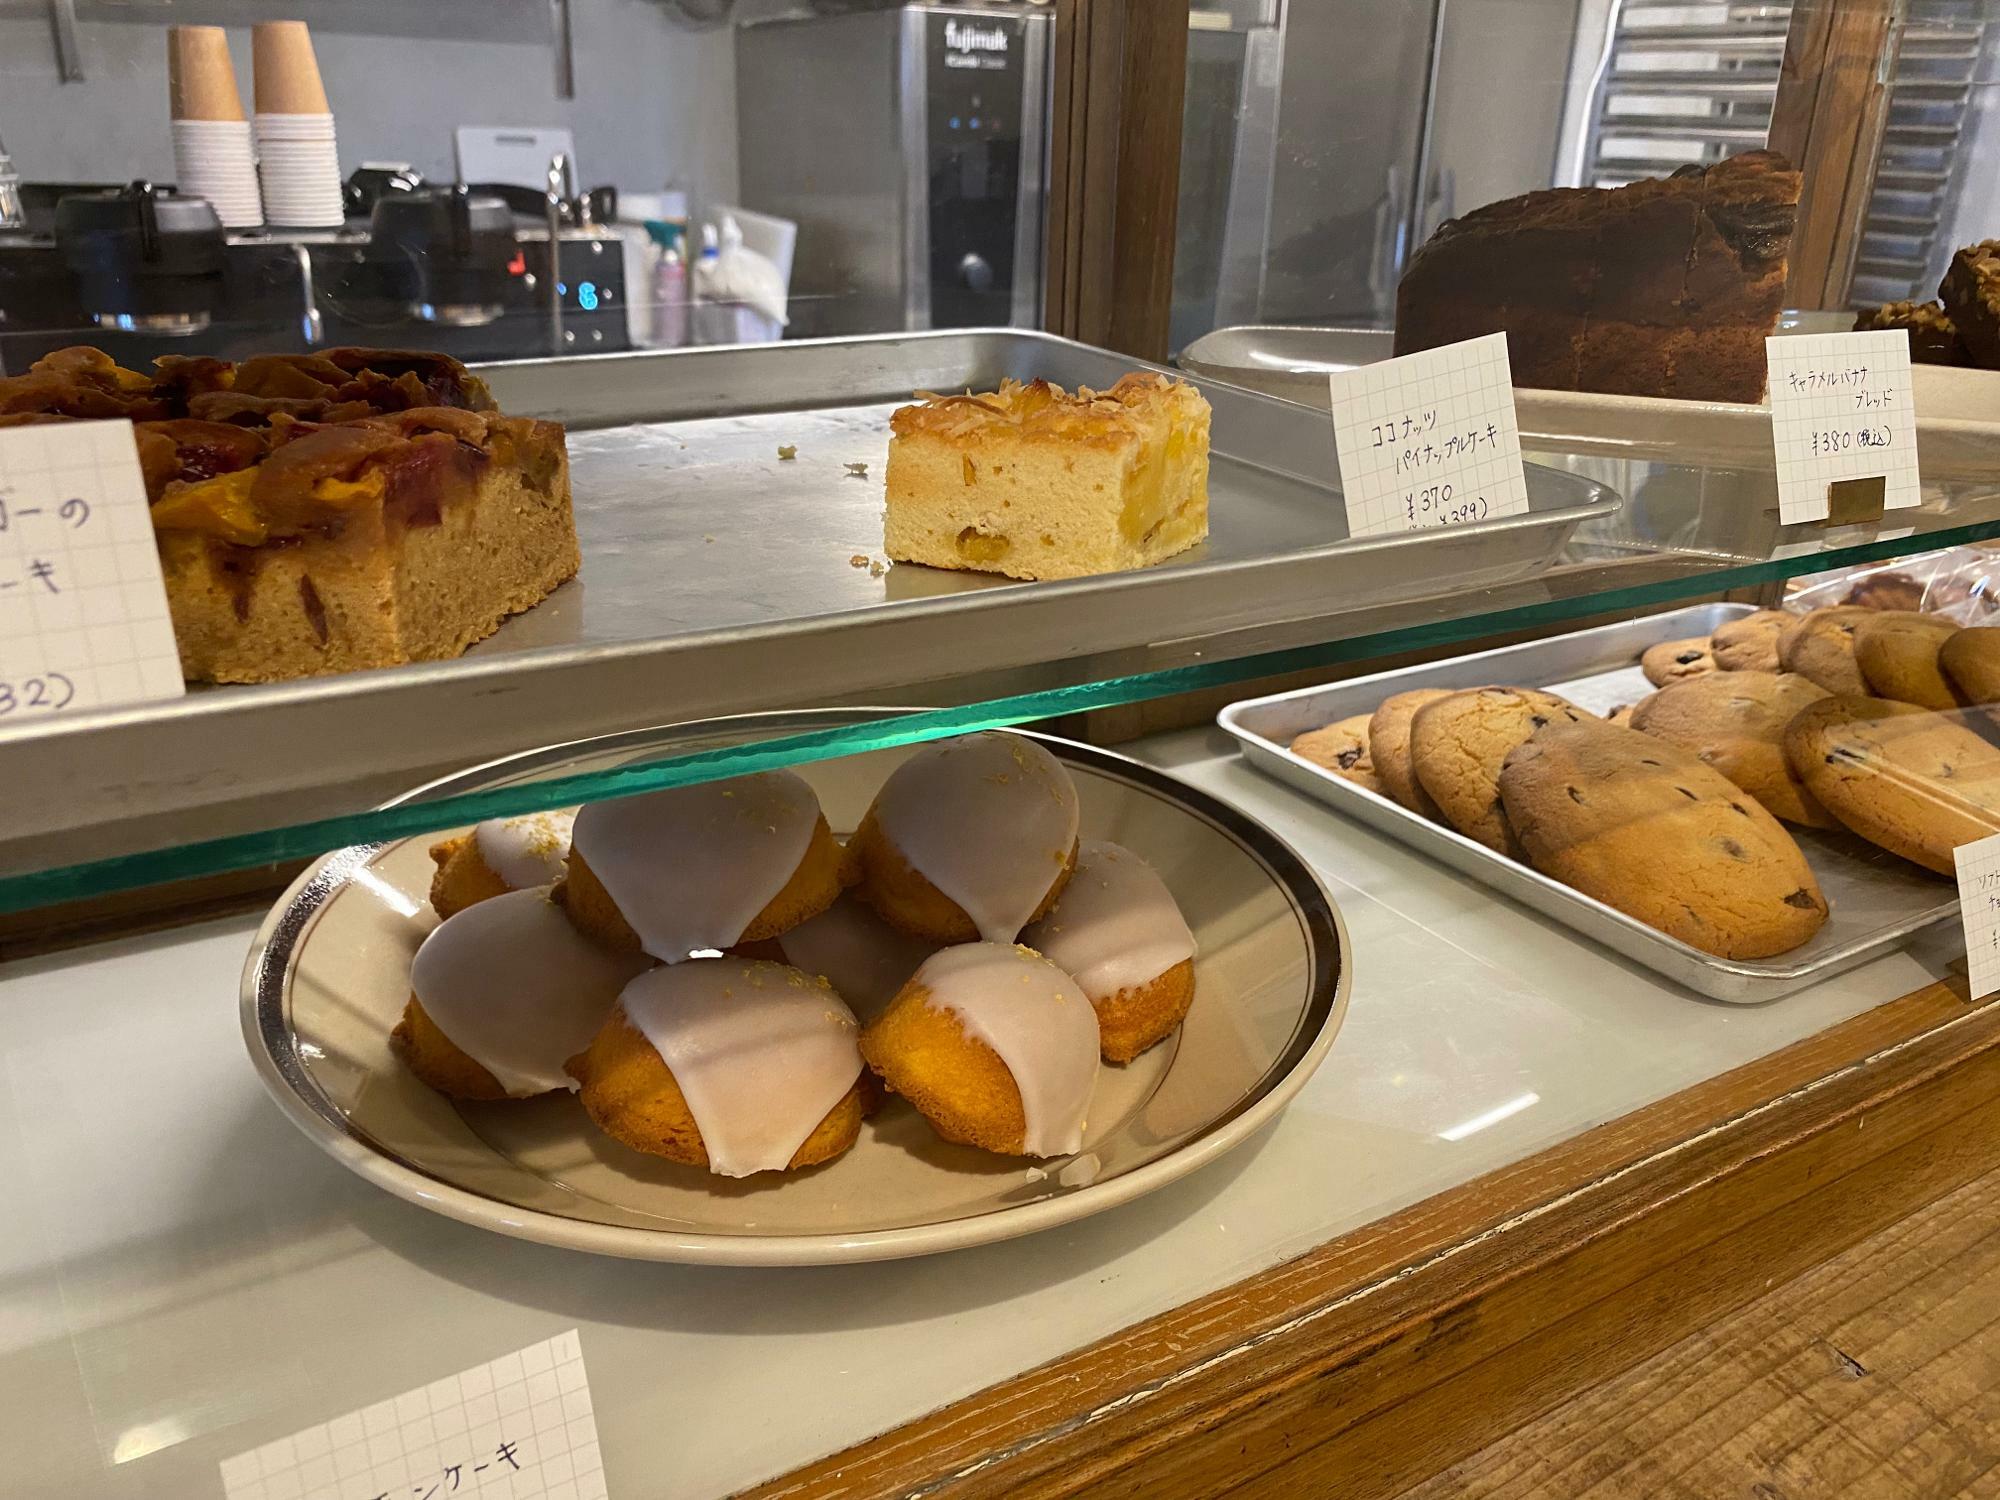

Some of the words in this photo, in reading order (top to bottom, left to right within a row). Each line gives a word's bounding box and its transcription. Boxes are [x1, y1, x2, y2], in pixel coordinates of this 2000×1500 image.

[1789, 365, 1868, 393] キャラメルバナナ
[1855, 388, 1893, 409] ブレッド
[1371, 410, 1437, 448] ココナッツ
[1396, 423, 1497, 475] パイナップルケーキ
